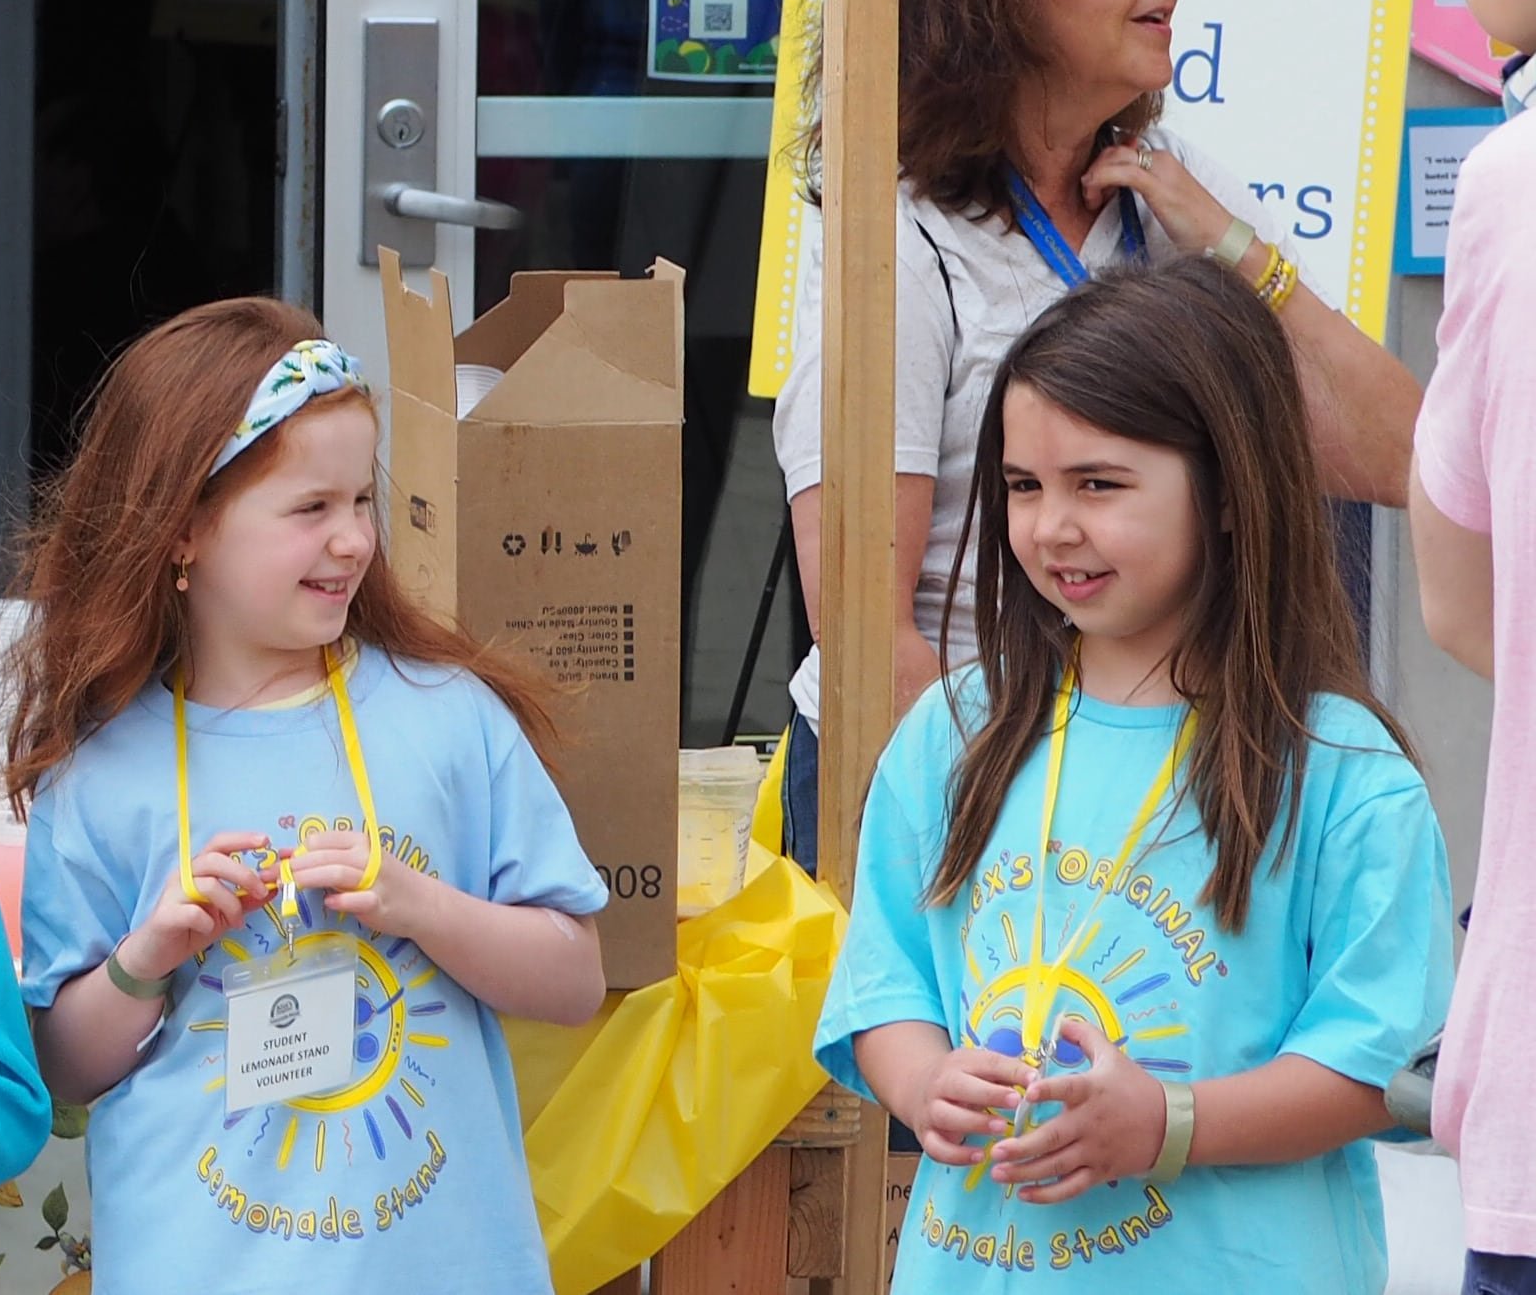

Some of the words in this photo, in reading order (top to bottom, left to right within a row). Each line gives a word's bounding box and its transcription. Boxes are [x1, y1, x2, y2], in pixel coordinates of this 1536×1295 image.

[262, 1031, 308, 1052] STUDENT
[240, 1052, 296, 1075] LEMONADE
[297, 1044, 330, 1061] STAND
[255, 1066, 314, 1089] VOLUNTEER
[196, 1145, 365, 1244] Lemonade
[373, 1130, 449, 1232] Stand
[1049, 1183, 1173, 1270] Stand
